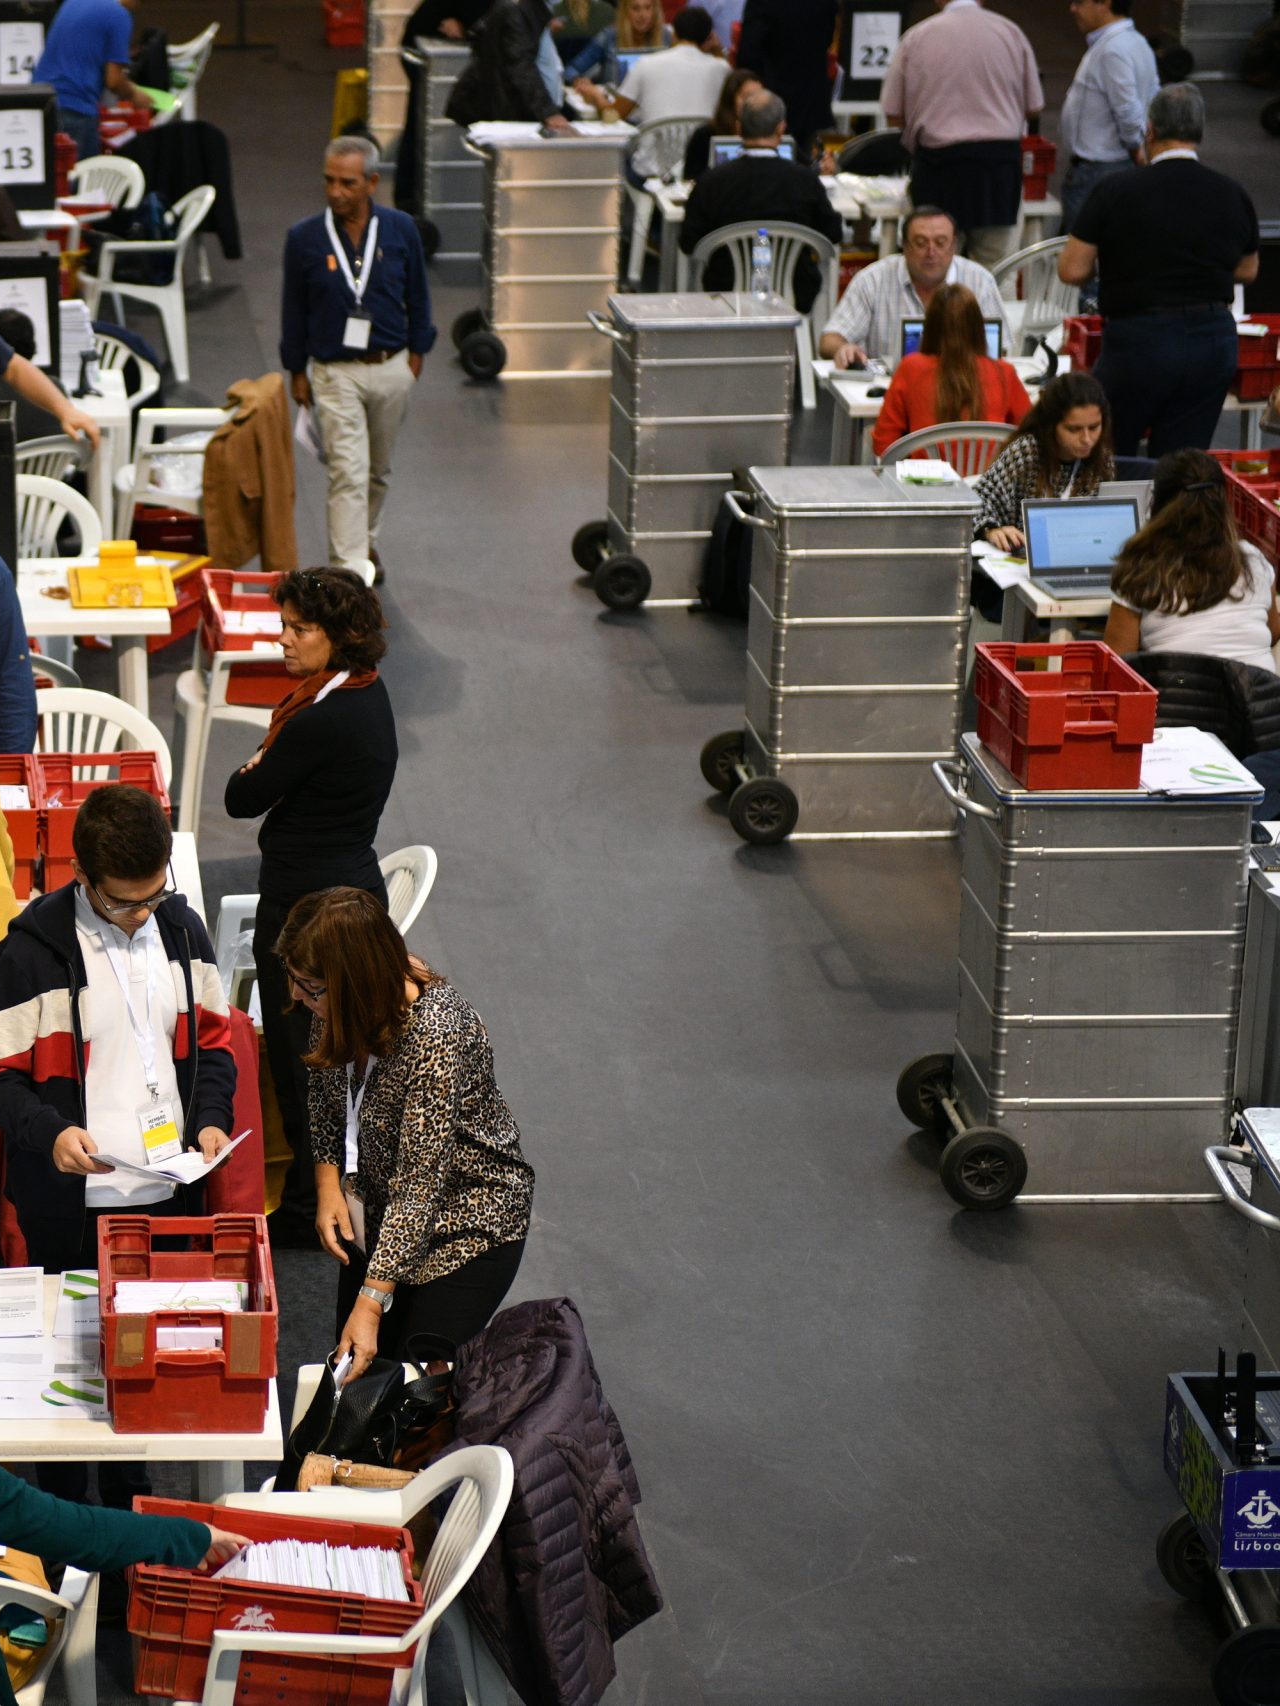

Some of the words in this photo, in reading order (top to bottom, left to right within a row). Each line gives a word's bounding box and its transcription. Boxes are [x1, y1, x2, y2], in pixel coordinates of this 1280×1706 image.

[7, 55, 35, 75] 14
[860, 45, 889, 67] 22
[2, 147, 34, 170] 13
[1257, 1530, 1280, 1538] Municipa
